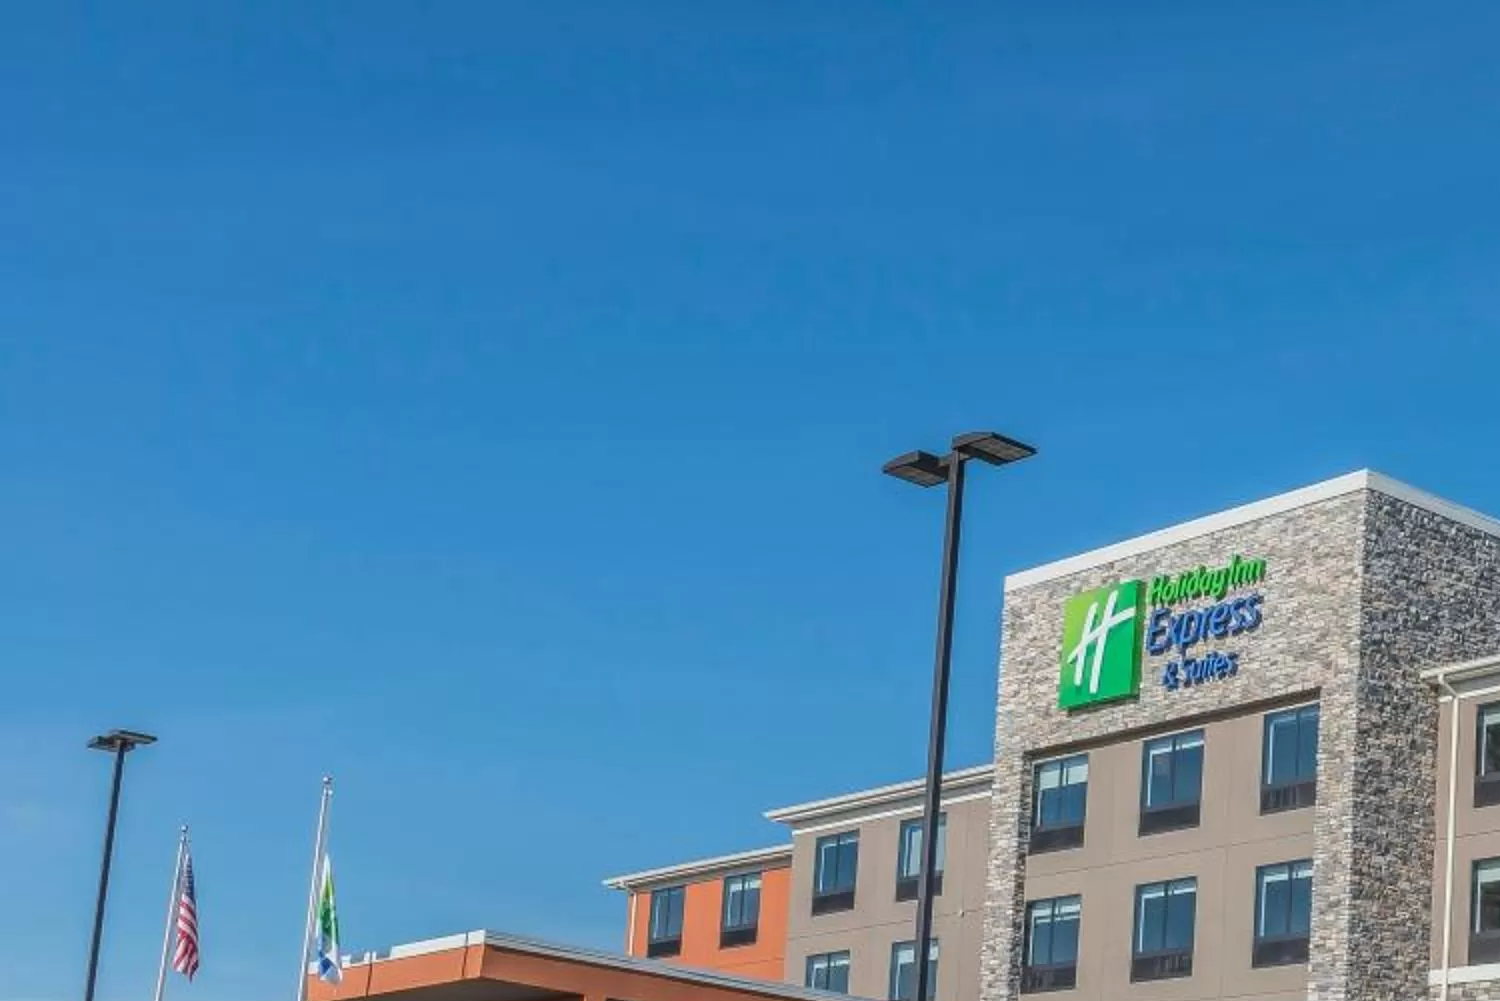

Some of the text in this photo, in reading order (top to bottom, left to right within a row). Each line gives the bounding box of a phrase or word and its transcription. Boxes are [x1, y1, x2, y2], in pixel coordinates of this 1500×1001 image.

[1146, 552, 1267, 608] Holiday Inn
[1146, 591, 1265, 657] Express
[1162, 650, 1240, 691] & Suites
